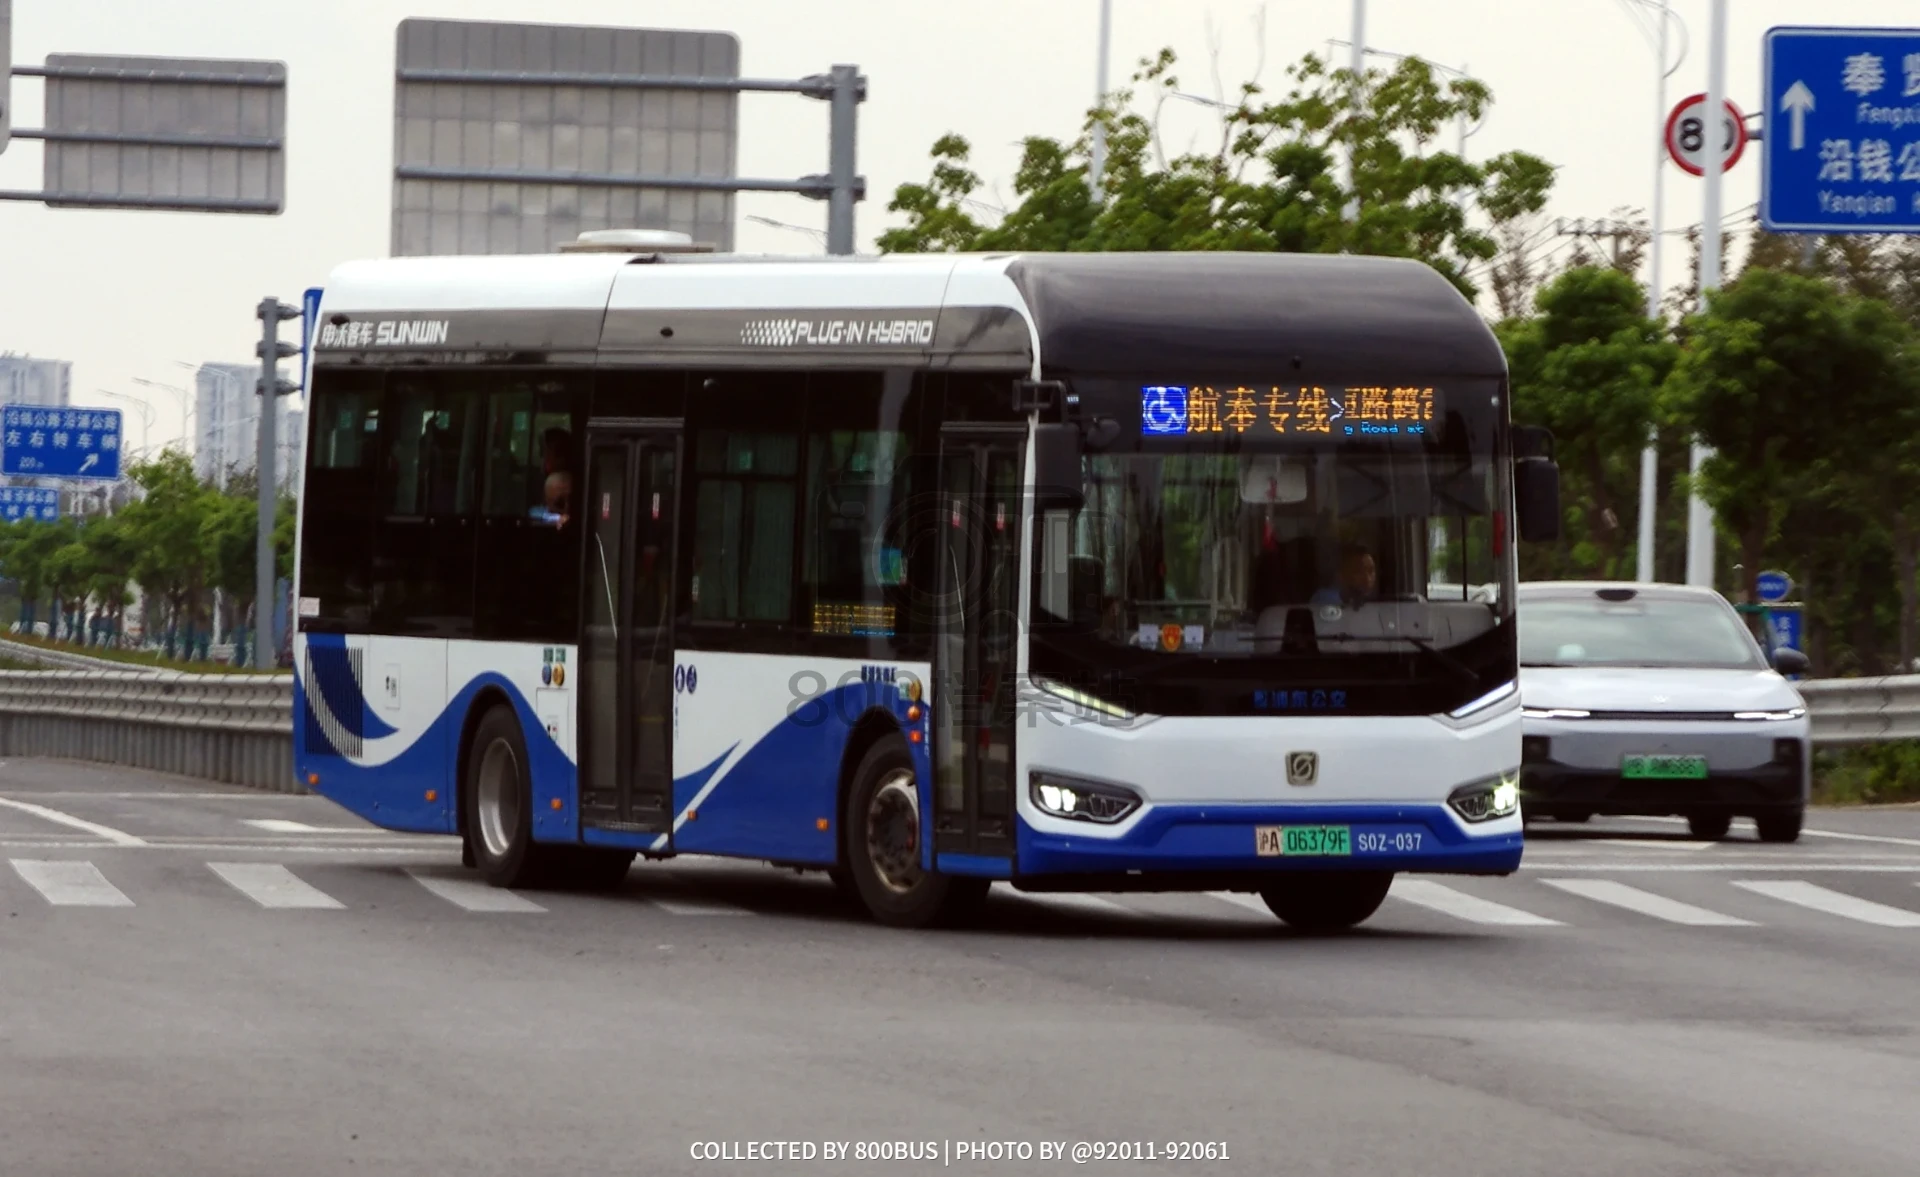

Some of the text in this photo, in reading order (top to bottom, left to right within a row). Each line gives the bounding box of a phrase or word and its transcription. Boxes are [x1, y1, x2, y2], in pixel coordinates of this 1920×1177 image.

[321, 320, 374, 348] 申沃客车
[375, 320, 449, 346] SUNWIN
[867, 320, 934, 345] HYBRID
[1187, 386, 1330, 432] 航奉专线
